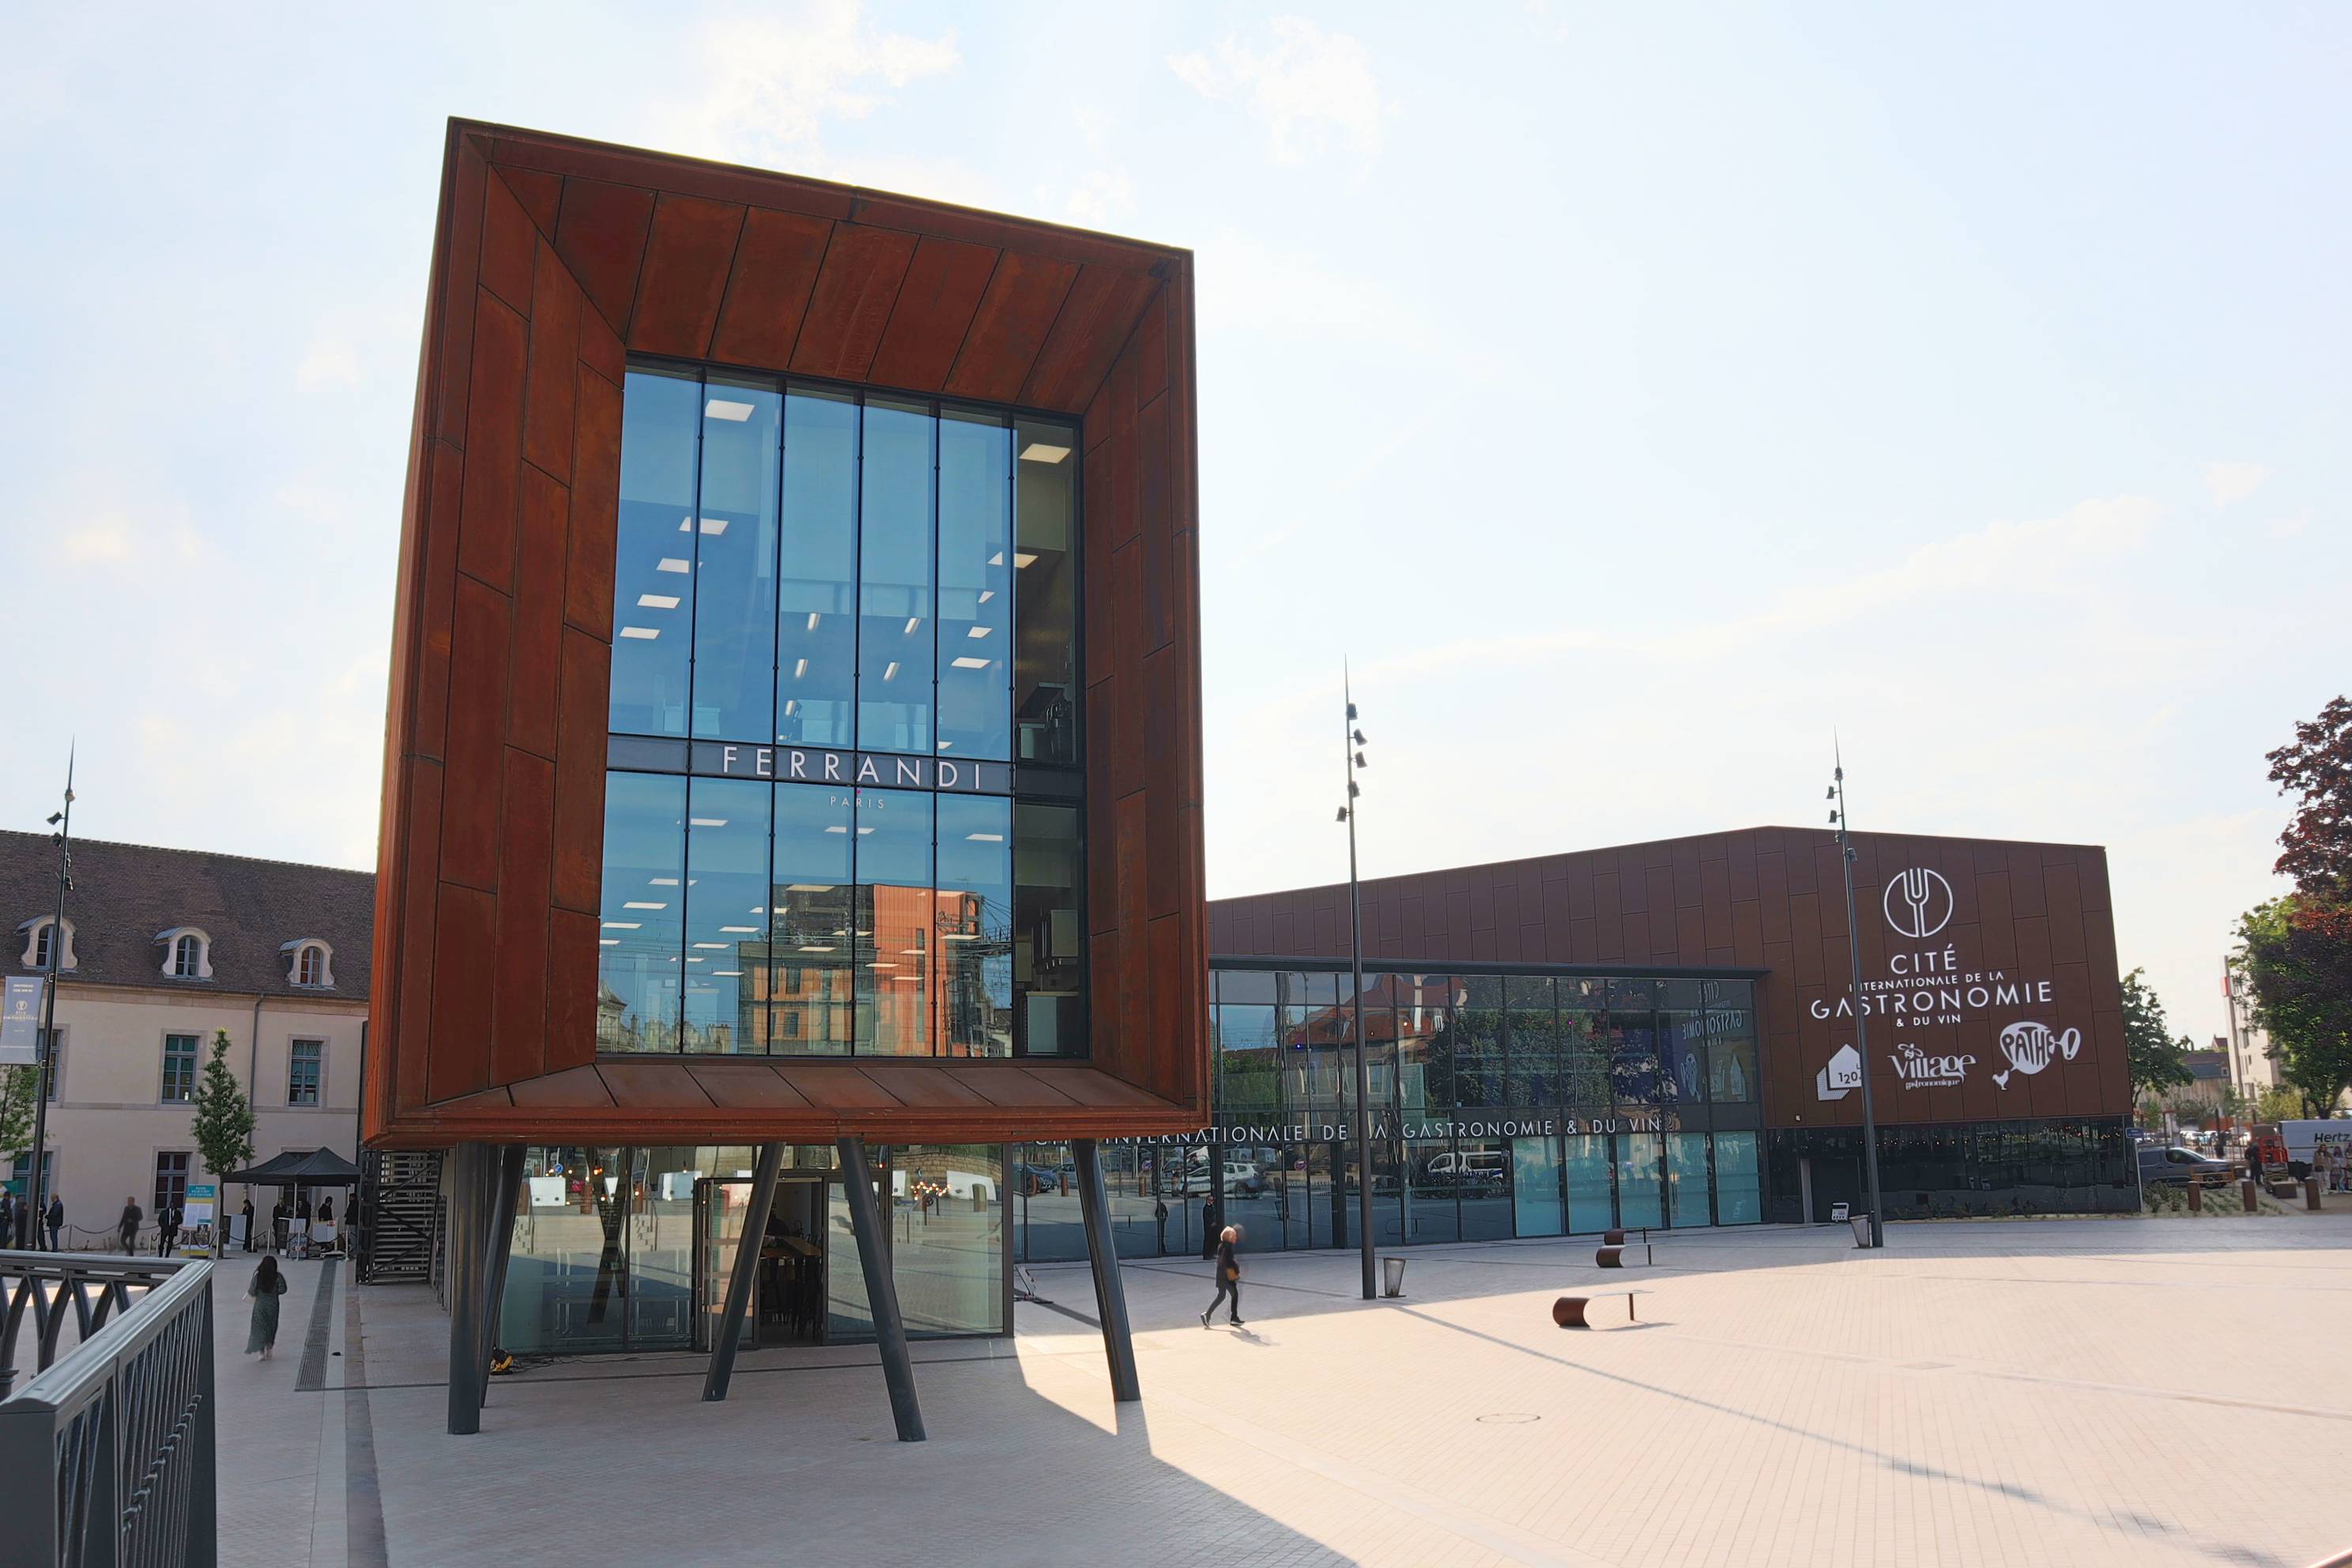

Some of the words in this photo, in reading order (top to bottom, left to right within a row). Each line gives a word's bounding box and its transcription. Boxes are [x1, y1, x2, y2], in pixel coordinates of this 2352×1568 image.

[723, 745, 981, 790] FERRANDI
[830, 795, 884, 810] PARIS
[1890, 943, 1957, 975] CITÉ
[1966, 973, 1981, 983] DE
[1989, 971, 2004, 982] LA
[1811, 981, 2053, 1020] GASTRONOMIE
[1897, 1017, 1905, 1027] &
[1913, 1015, 1930, 1026] DU
[1938, 1014, 1962, 1024] VIN
[1838, 1071, 1862, 1084] 120
[1887, 1054, 1976, 1084] Village
[1323, 1125, 1347, 1140] DE
[1402, 1121, 1554, 1138] GASTRONOMIE
[1566, 1120, 1577, 1135] &
[1593, 1118, 1616, 1134] DU
[1629, 1117, 1661, 1133] VIN
[2314, 1132, 2351, 1144] Hertz
